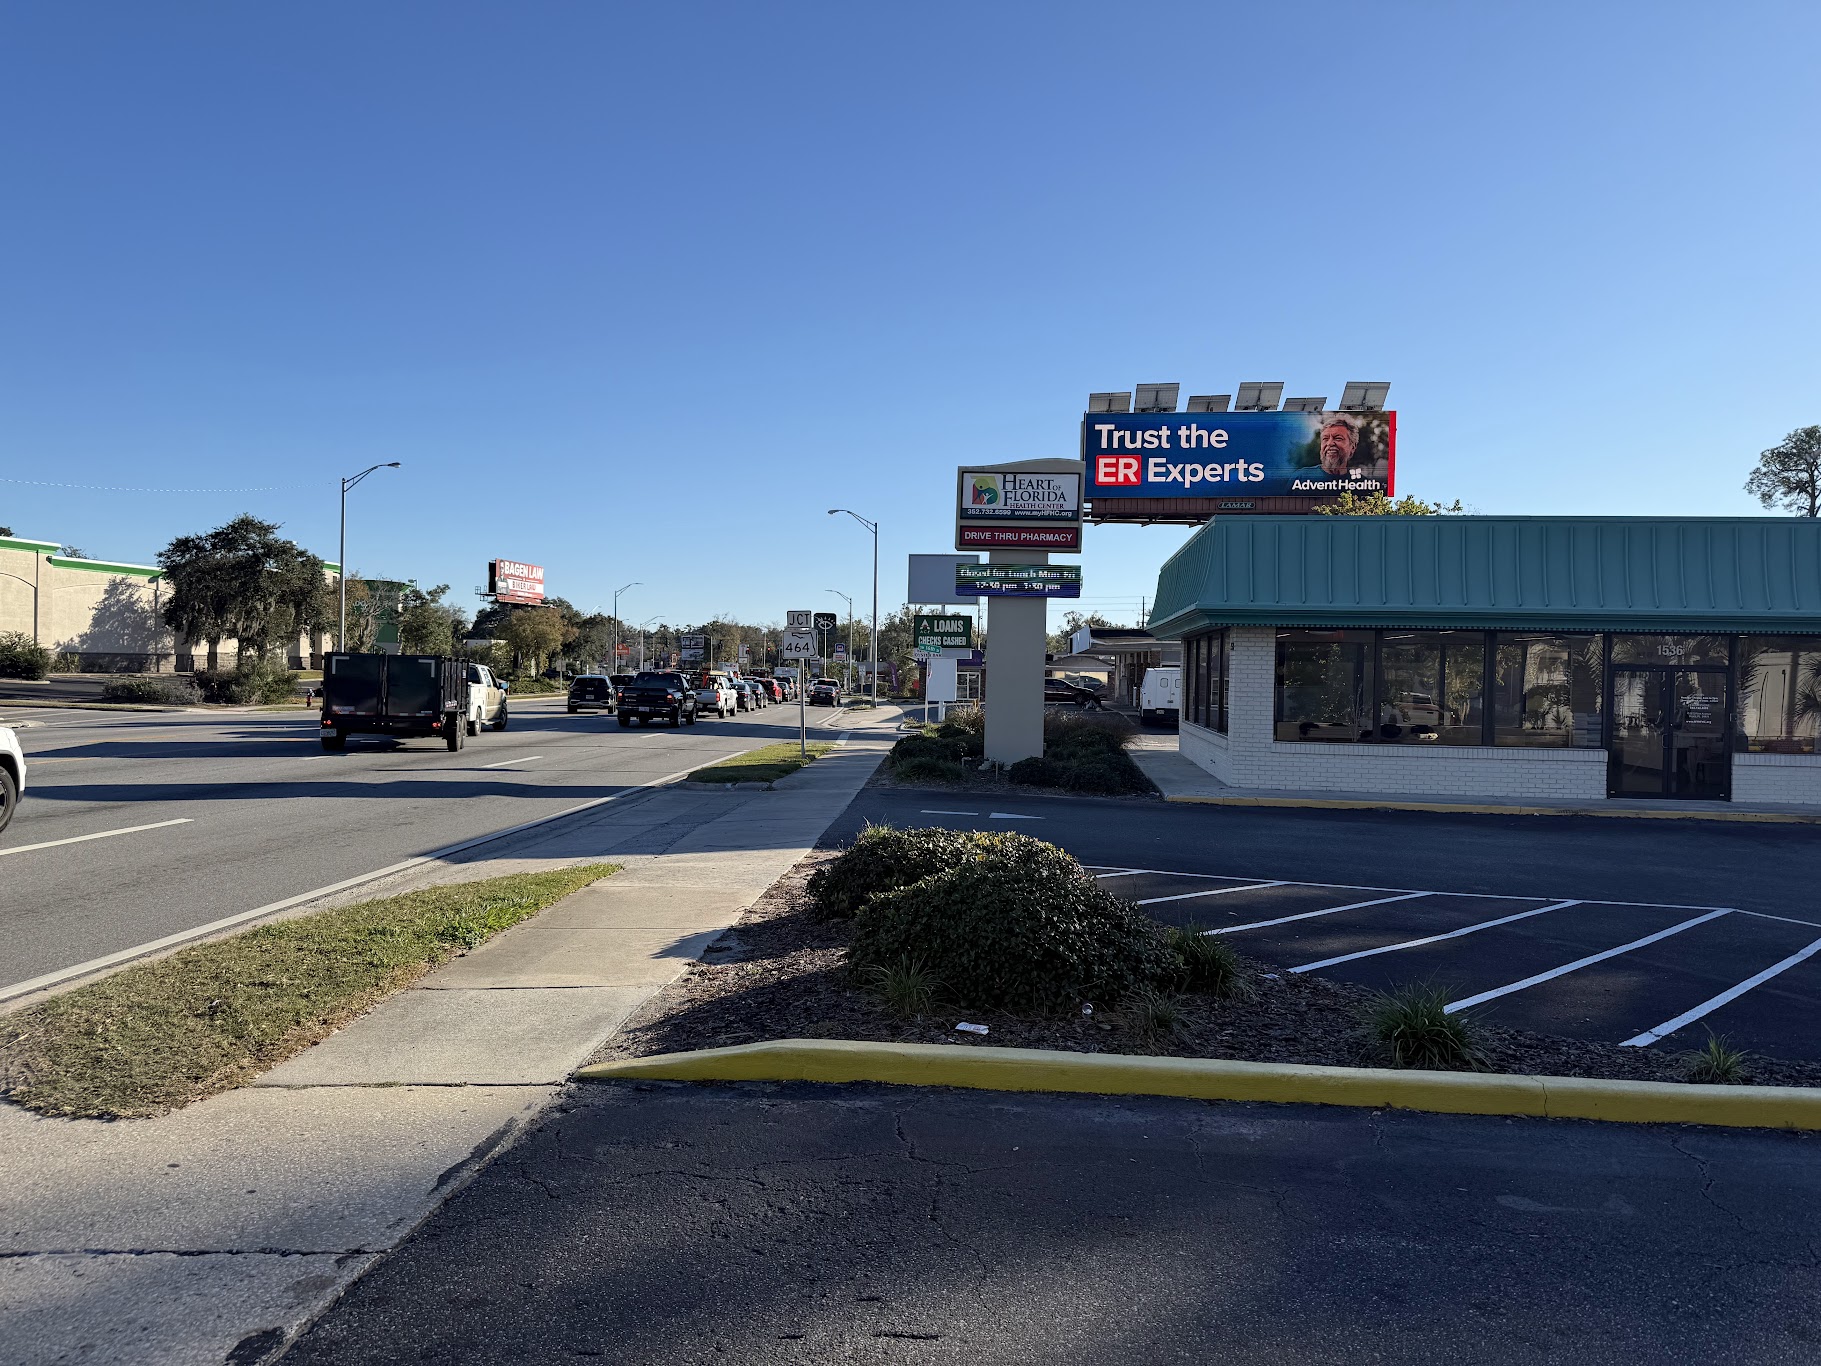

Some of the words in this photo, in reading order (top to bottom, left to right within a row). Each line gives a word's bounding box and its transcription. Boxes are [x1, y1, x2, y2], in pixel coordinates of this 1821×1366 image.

[1094, 424, 1171, 449] Trust
[1177, 423, 1229, 448] the
[1098, 457, 1139, 483] ER
[1148, 457, 1265, 489] Experts
[1001, 473, 1054, 491] HEART
[1002, 491, 1067, 507] FLORIDA
[964, 531, 992, 540] DRIVE
[993, 532, 1018, 541] THRU
[1020, 533, 1073, 542] PHARMACY
[505, 561, 528, 577] BAGEN
[529, 567, 543, 579] LAW
[993, 569, 1006, 577] for
[1008, 569, 1036, 578] Lunch
[789, 614, 809, 625] JCT
[933, 619, 964, 633] LOANS
[785, 643, 809, 652] 464
[918, 636, 942, 646] CHECKS
[943, 636, 967, 646] CASHED
[1656, 644, 1683, 656] 1536
